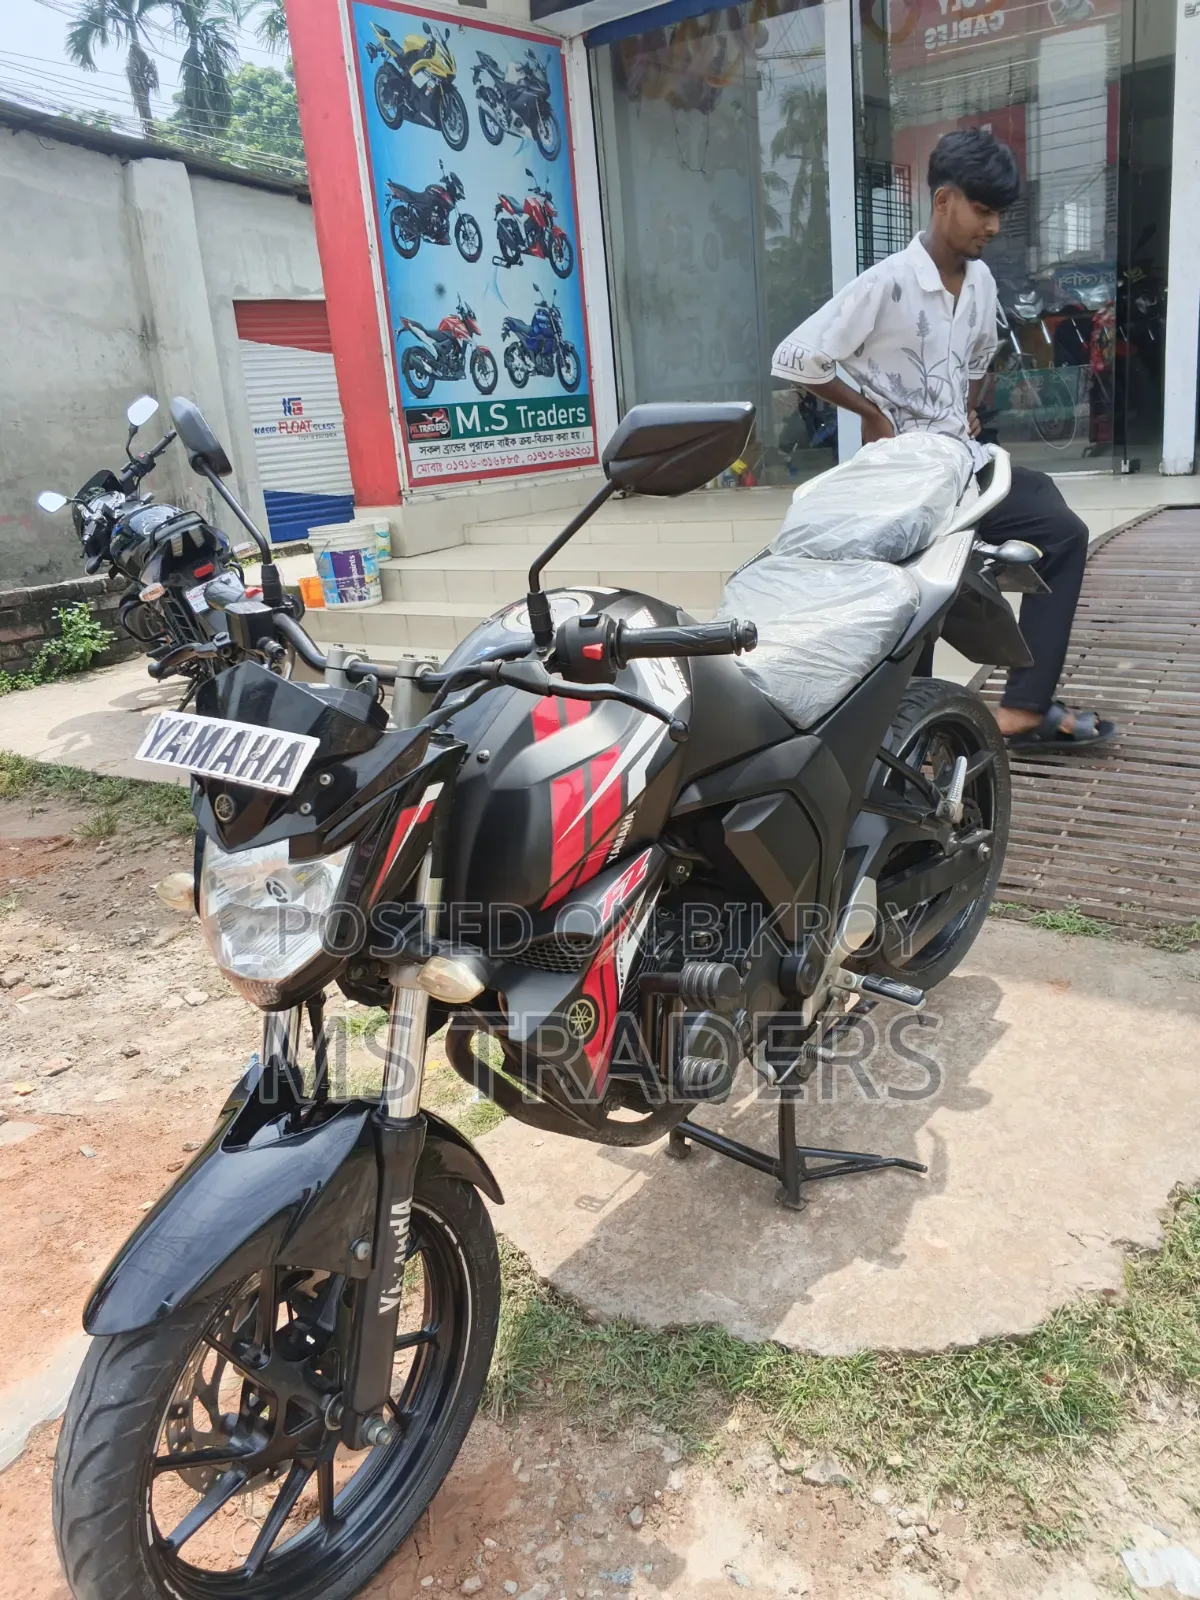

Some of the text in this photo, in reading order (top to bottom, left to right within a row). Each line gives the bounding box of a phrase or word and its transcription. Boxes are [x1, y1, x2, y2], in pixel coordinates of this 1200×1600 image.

[278, 420, 312, 434] FLOAT
[419, 422, 449, 433] TRADERS
[455, 402, 586, 434] M.S Traders
[419, 445, 440, 455] সকল
[497, 436, 516, 448] বাইক
[555, 433, 569, 441] করা
[143, 717, 306, 788] YAMAHA
[606, 810, 636, 863] YAMAHA
[597, 848, 652, 926] FZ
